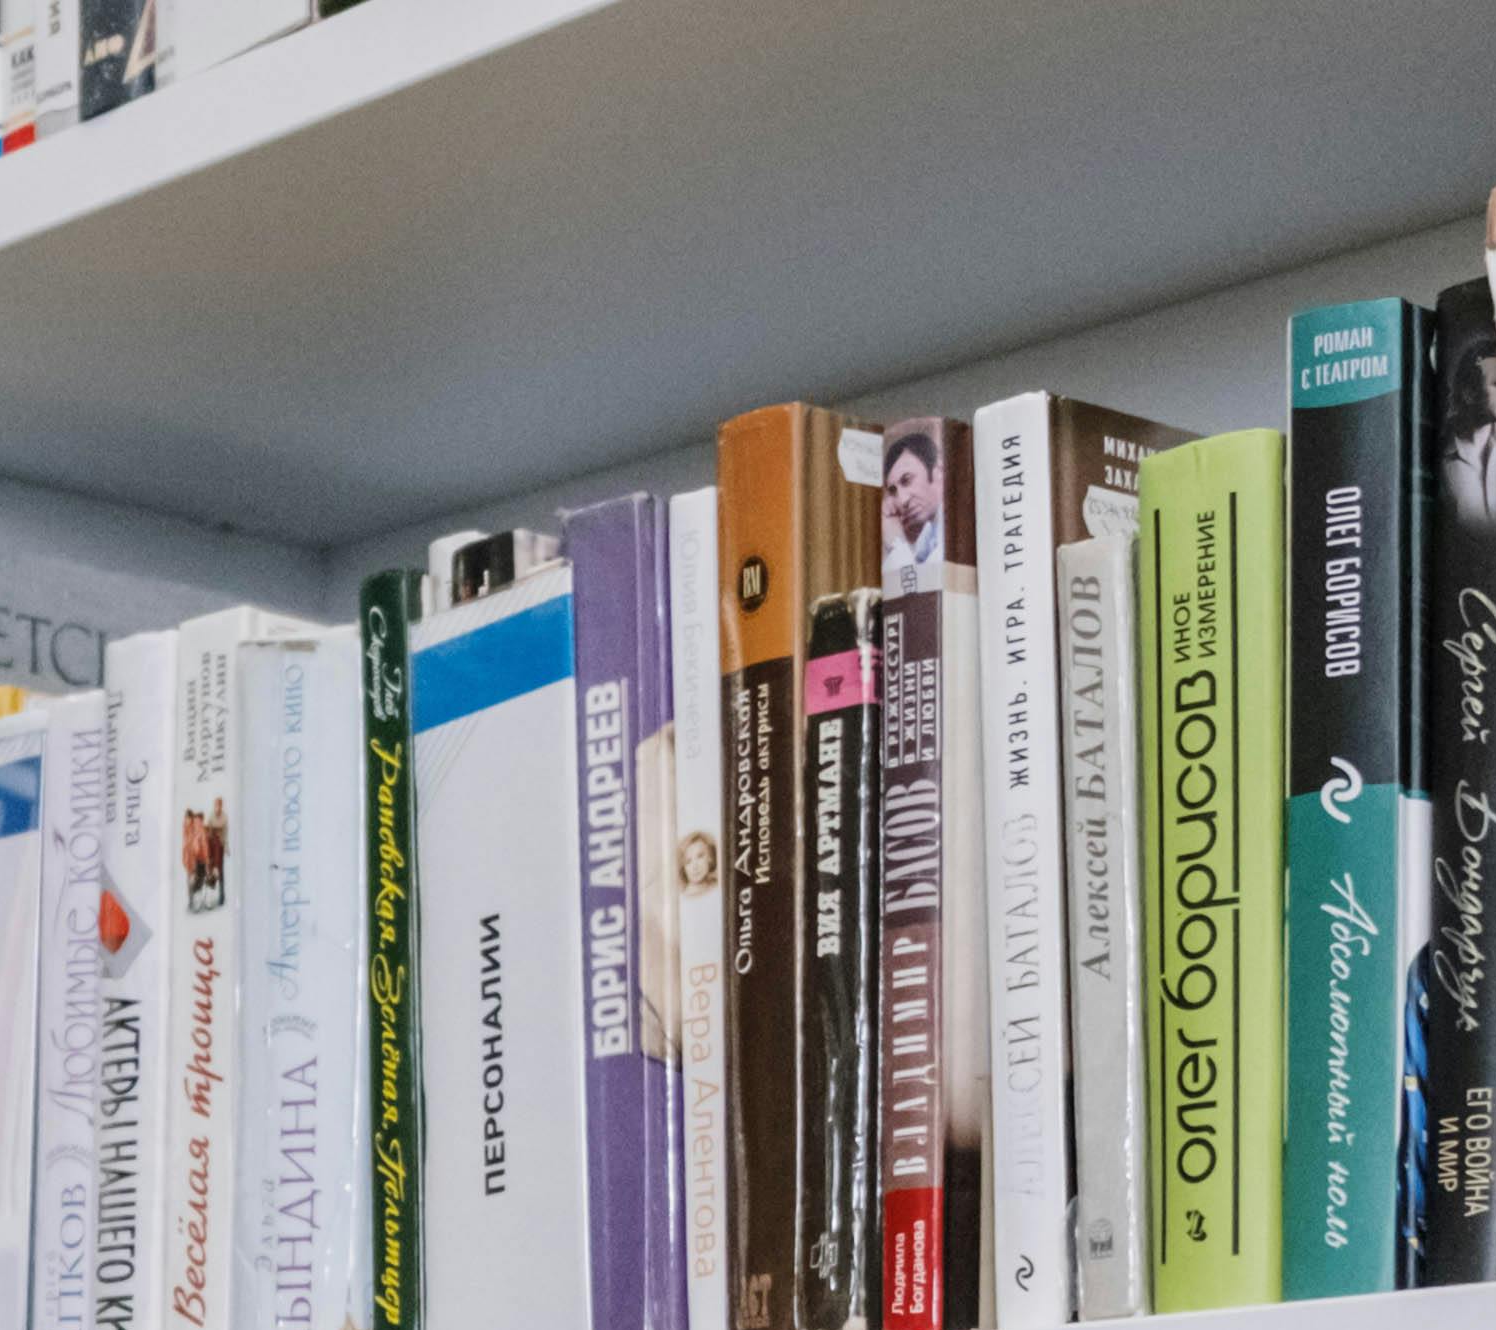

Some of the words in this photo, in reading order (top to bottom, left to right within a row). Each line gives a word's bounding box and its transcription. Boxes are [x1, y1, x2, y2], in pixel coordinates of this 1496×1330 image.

[1314, 327, 1373, 357] РОМАН
[1197, 510, 1217, 657] ИЗМЕРЕНИЕ
[1326, 486, 1361, 547] ОЛЕГ
[886, 614, 899, 747] РЕЖИССУРЕ
[1071, 575, 1107, 802] БАТАЛОВ
[1173, 592, 1191, 663] ИНОЕ
[1325, 556, 1360, 678] БОРИСОВ
[585, 683, 624, 888] АНДРЕЕВ
[816, 718, 843, 875] АРТМАНЕ
[882, 779, 940, 914] БАСОВ
[1162, 669, 1239, 1010] борисов
[816, 890, 841, 958] ВИЯ
[1075, 818, 1111, 981] Алексей
[184, 937, 224, 1118] троица
[480, 914, 506, 1195] ПЕРСОНАЛИИ
[591, 903, 627, 1057] БОРИС
[687, 962, 718, 1063] Вера
[1320, 873, 1378, 1146] Абсолютный
[893, 937, 935, 1177] ВЛАДИМИР
[1177, 1028, 1218, 1184] олег
[1465, 1088, 1493, 1130] ЕГО
[96, 1139, 138, 1284] НАШЕГО
[174, 1137, 209, 1327] Весёлая
[693, 1077, 720, 1279] Алентова
[1327, 1160, 1350, 1249] ноль
[1464, 1137, 1493, 1217] ВОЙНА
